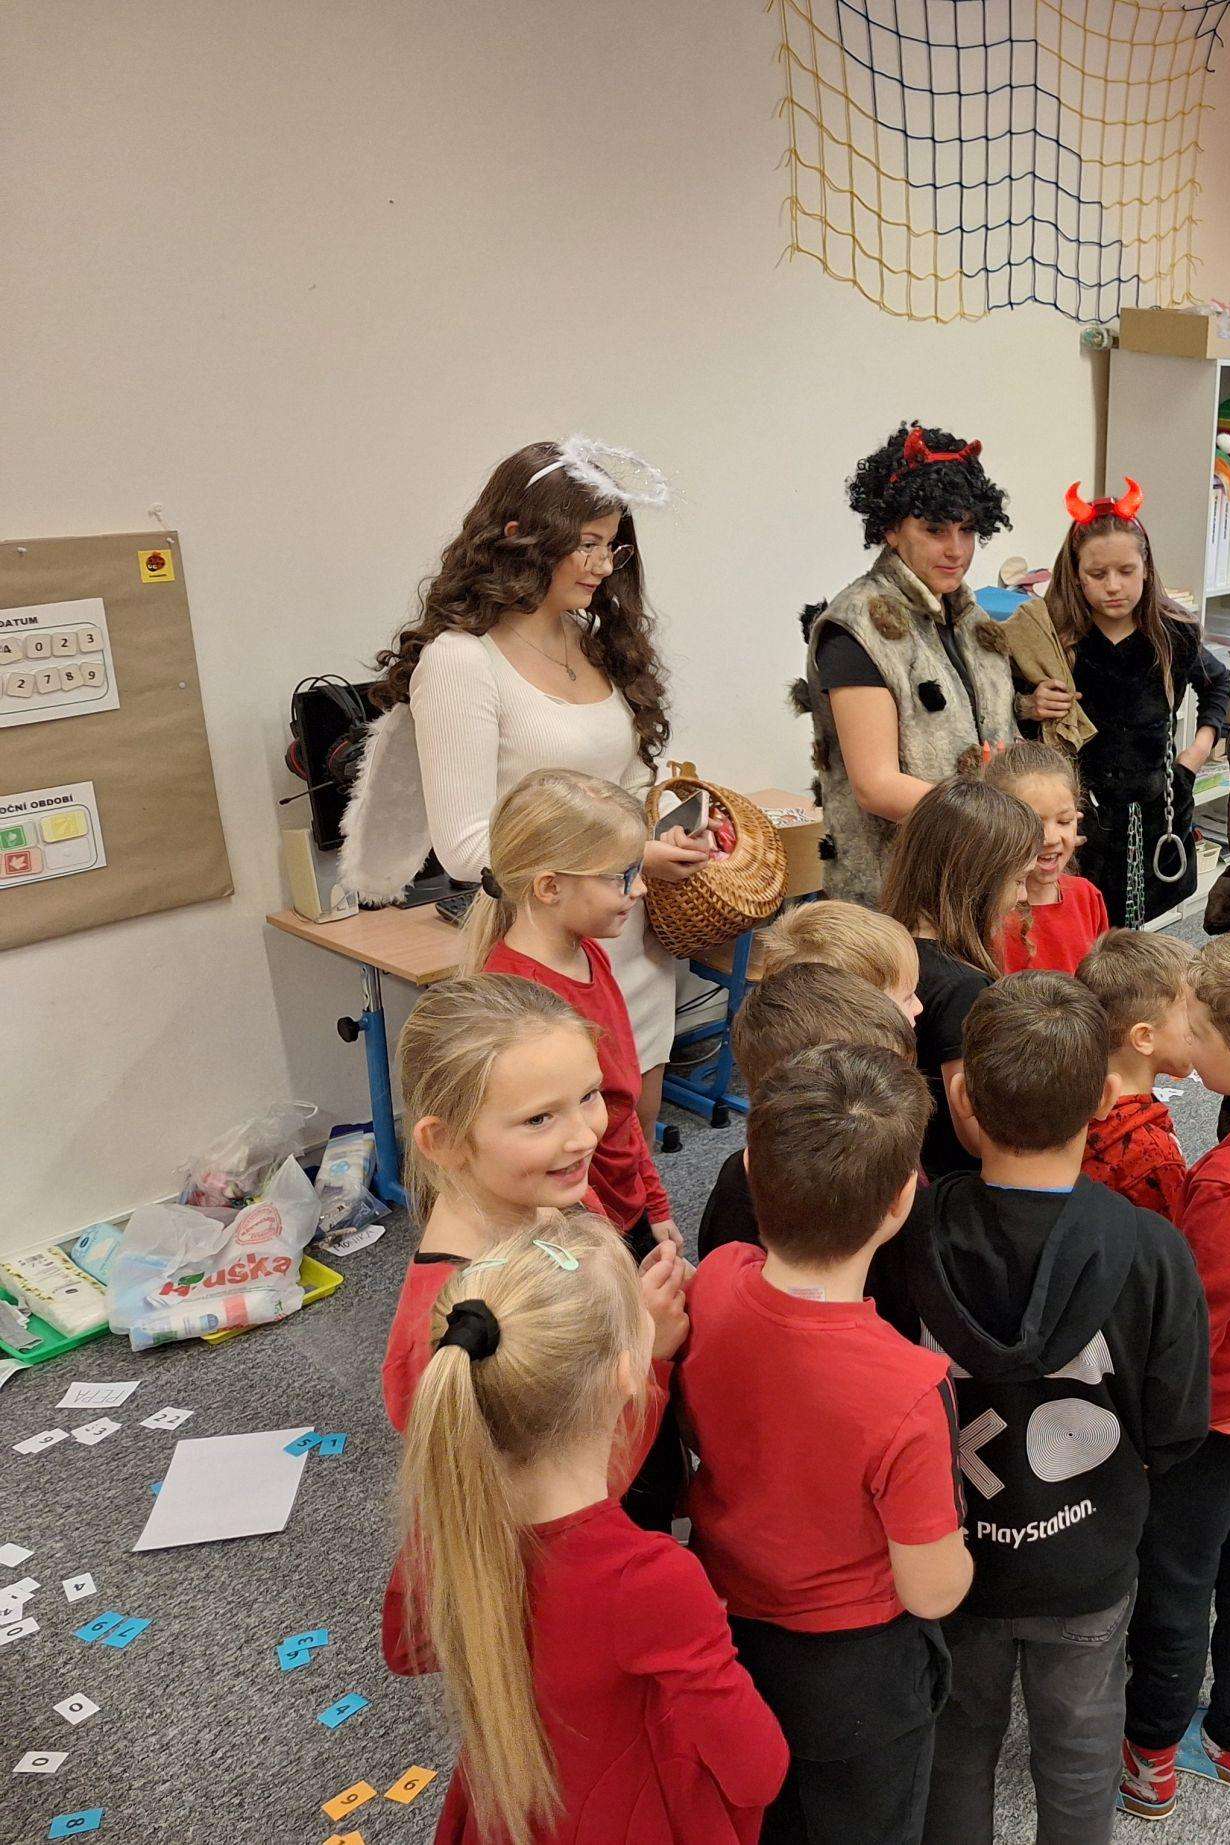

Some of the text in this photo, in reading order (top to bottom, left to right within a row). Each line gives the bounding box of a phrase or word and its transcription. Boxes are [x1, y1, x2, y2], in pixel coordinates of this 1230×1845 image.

[35, 642, 43, 651] 0
[60, 638, 68, 648] 2
[86, 633, 94, 643] 3
[17, 670, 96, 689] 2 7 8 9
[30, 794, 74, 809] OBDOBÍ
[68, 1702, 83, 1713] 0
[31, 1757, 49, 1767] 0
[65, 1817, 85, 1829] 8
